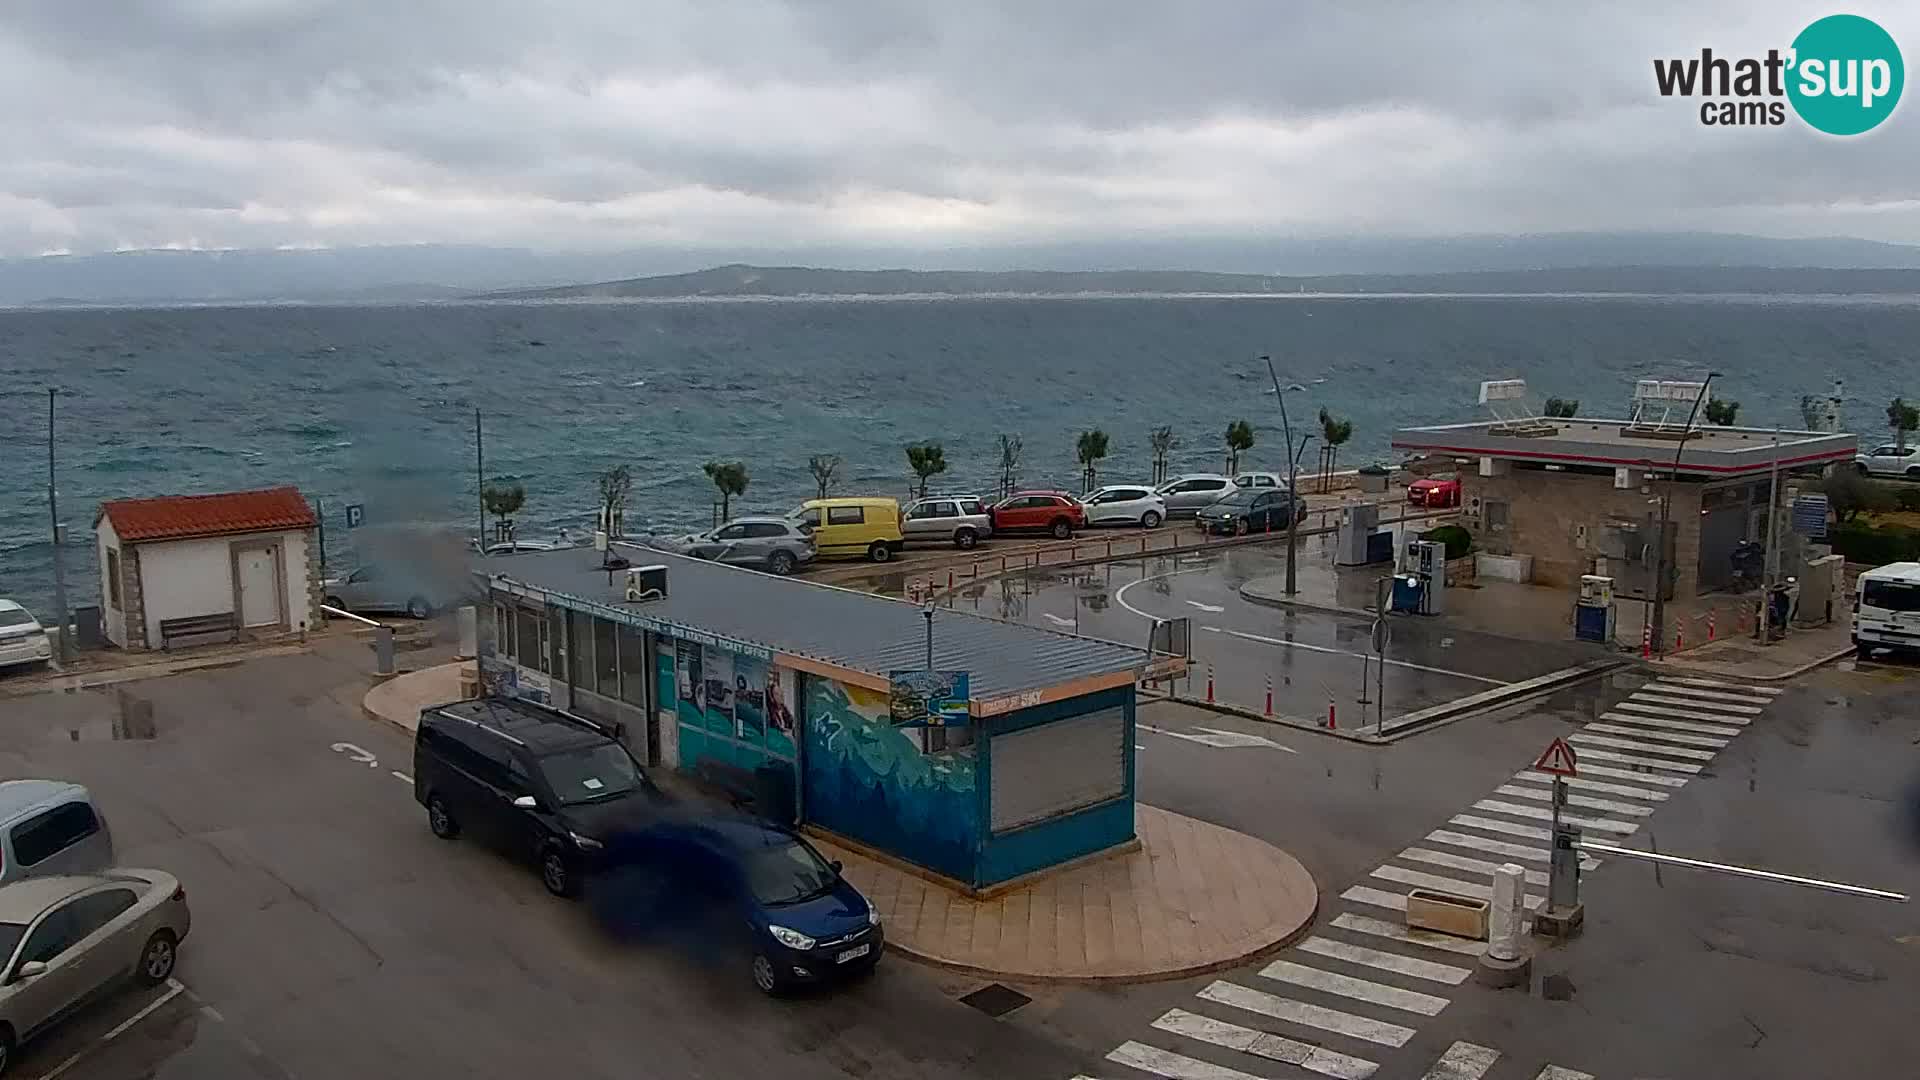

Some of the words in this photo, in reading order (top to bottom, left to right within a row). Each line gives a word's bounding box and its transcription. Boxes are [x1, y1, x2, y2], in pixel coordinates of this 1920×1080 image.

[351, 507, 361, 525] P
[718, 637, 743, 654] TICKET
[744, 644, 770, 660] OFFICE
